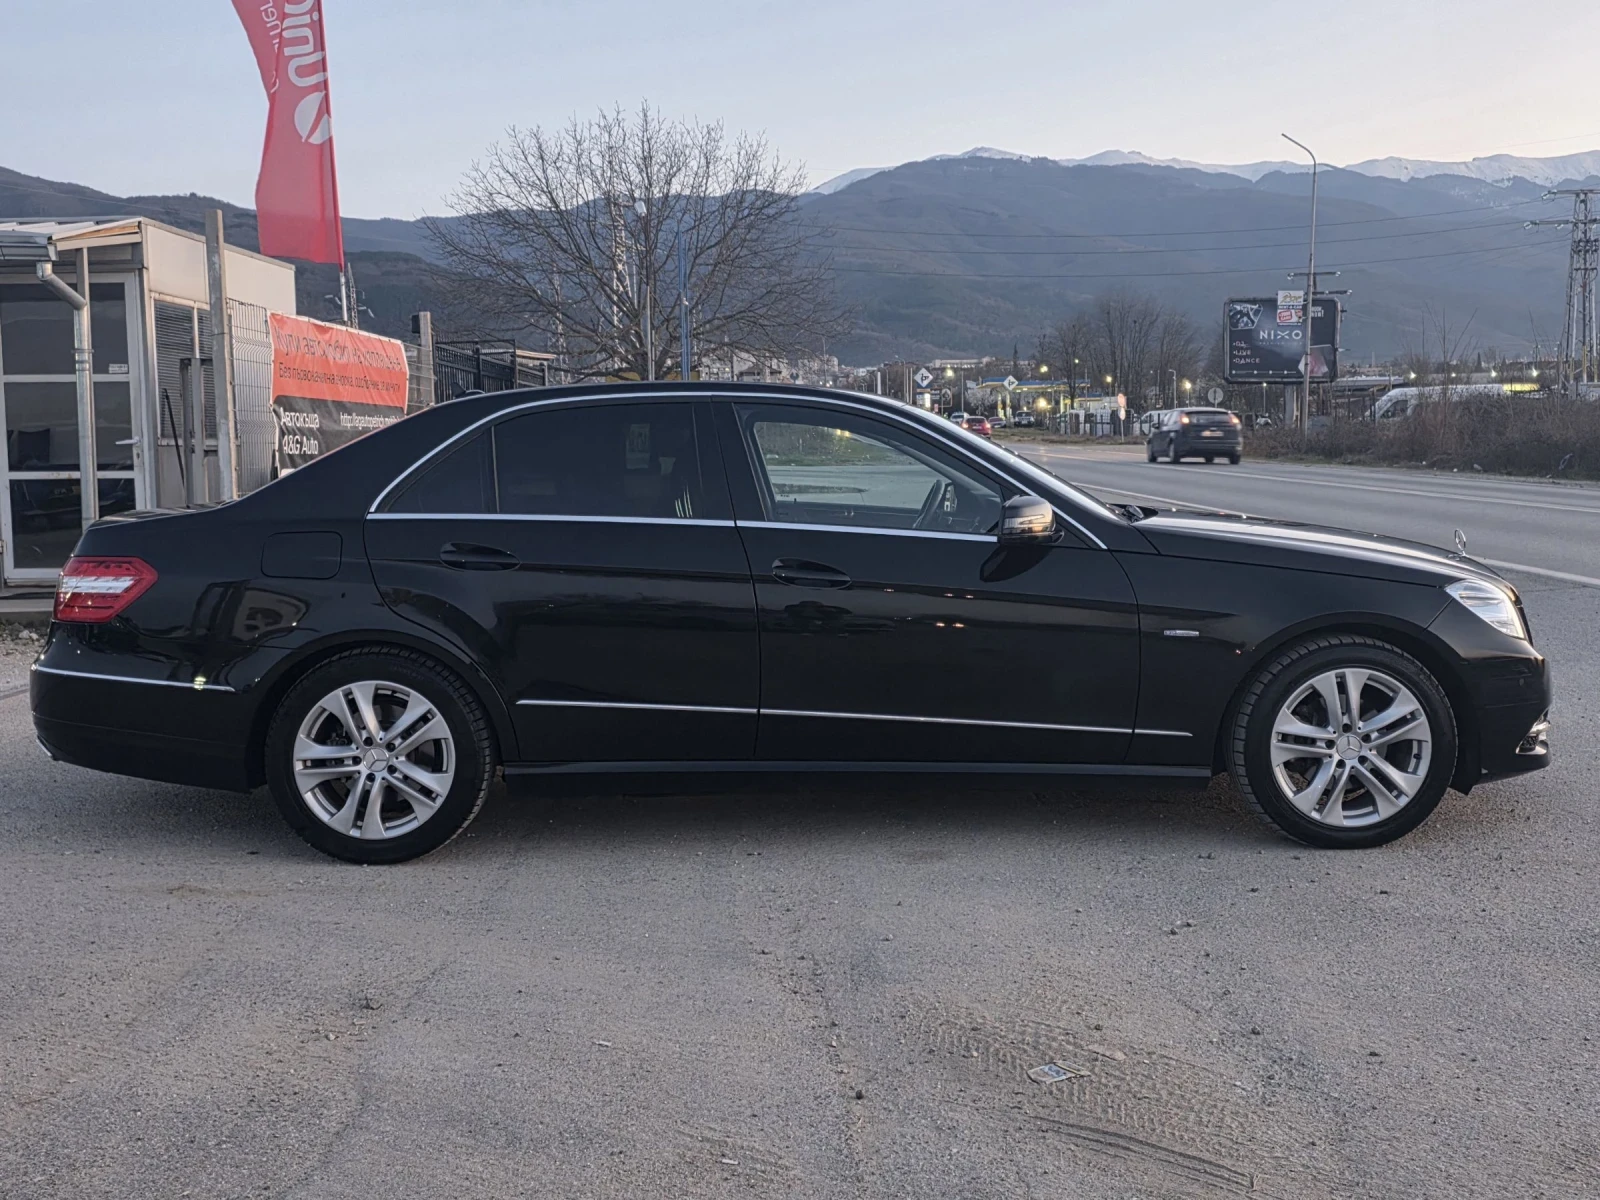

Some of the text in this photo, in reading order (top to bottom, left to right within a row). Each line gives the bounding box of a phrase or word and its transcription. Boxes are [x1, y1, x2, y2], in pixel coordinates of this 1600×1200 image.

[1259, 329, 1303, 340] NIXO
[279, 361, 292, 379] Без
[1235, 357, 1261, 365] DANCE
[280, 406, 320, 431] Автокъща
[282, 434, 319, 455] A&G Auto
